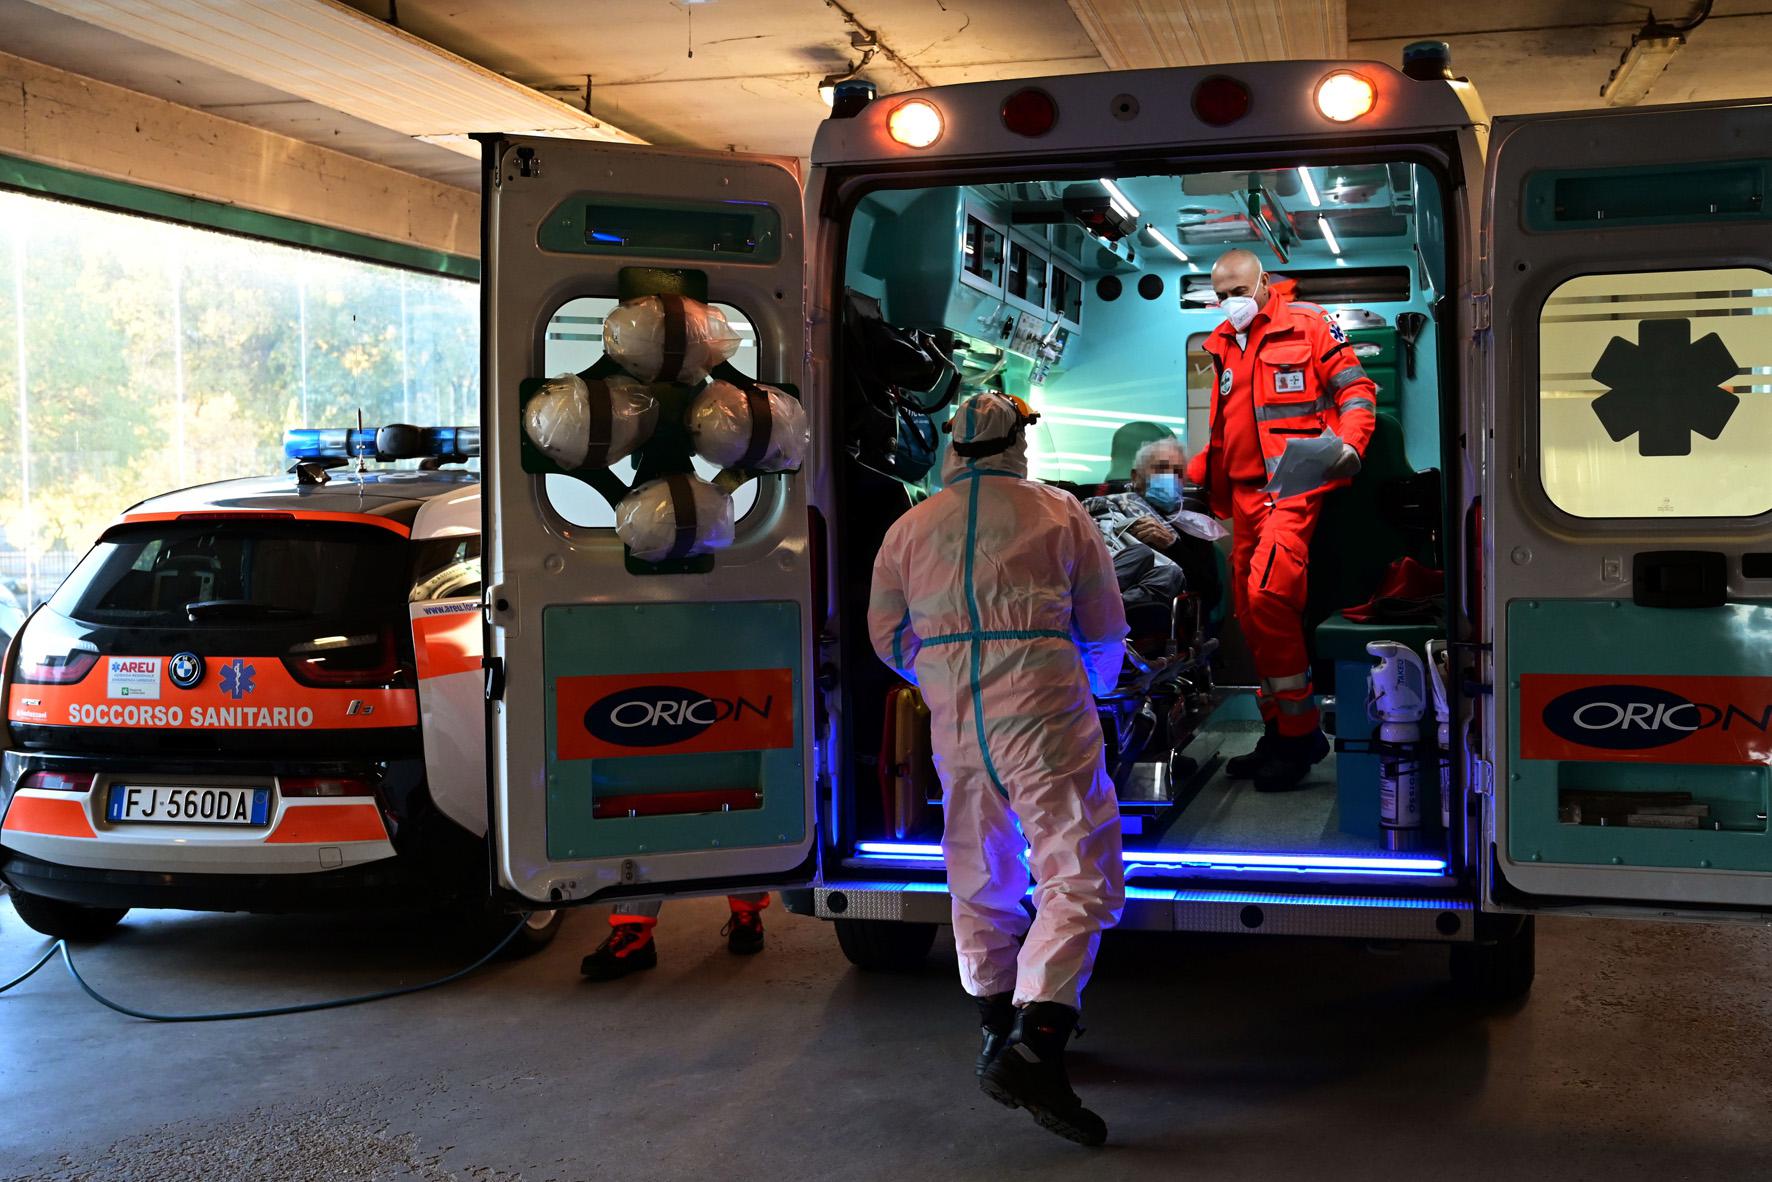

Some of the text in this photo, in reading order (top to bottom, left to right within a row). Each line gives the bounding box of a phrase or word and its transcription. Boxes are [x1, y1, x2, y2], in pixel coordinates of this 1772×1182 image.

[120, 662, 155, 673] AREU
[68, 703, 183, 726] SOCCORSO
[190, 706, 314, 727] SANITARIO
[610, 695, 773, 727] ORION
[1573, 702, 1772, 731] ORION
[125, 789, 158, 818] FJ
[166, 789, 248, 821] 560DA
